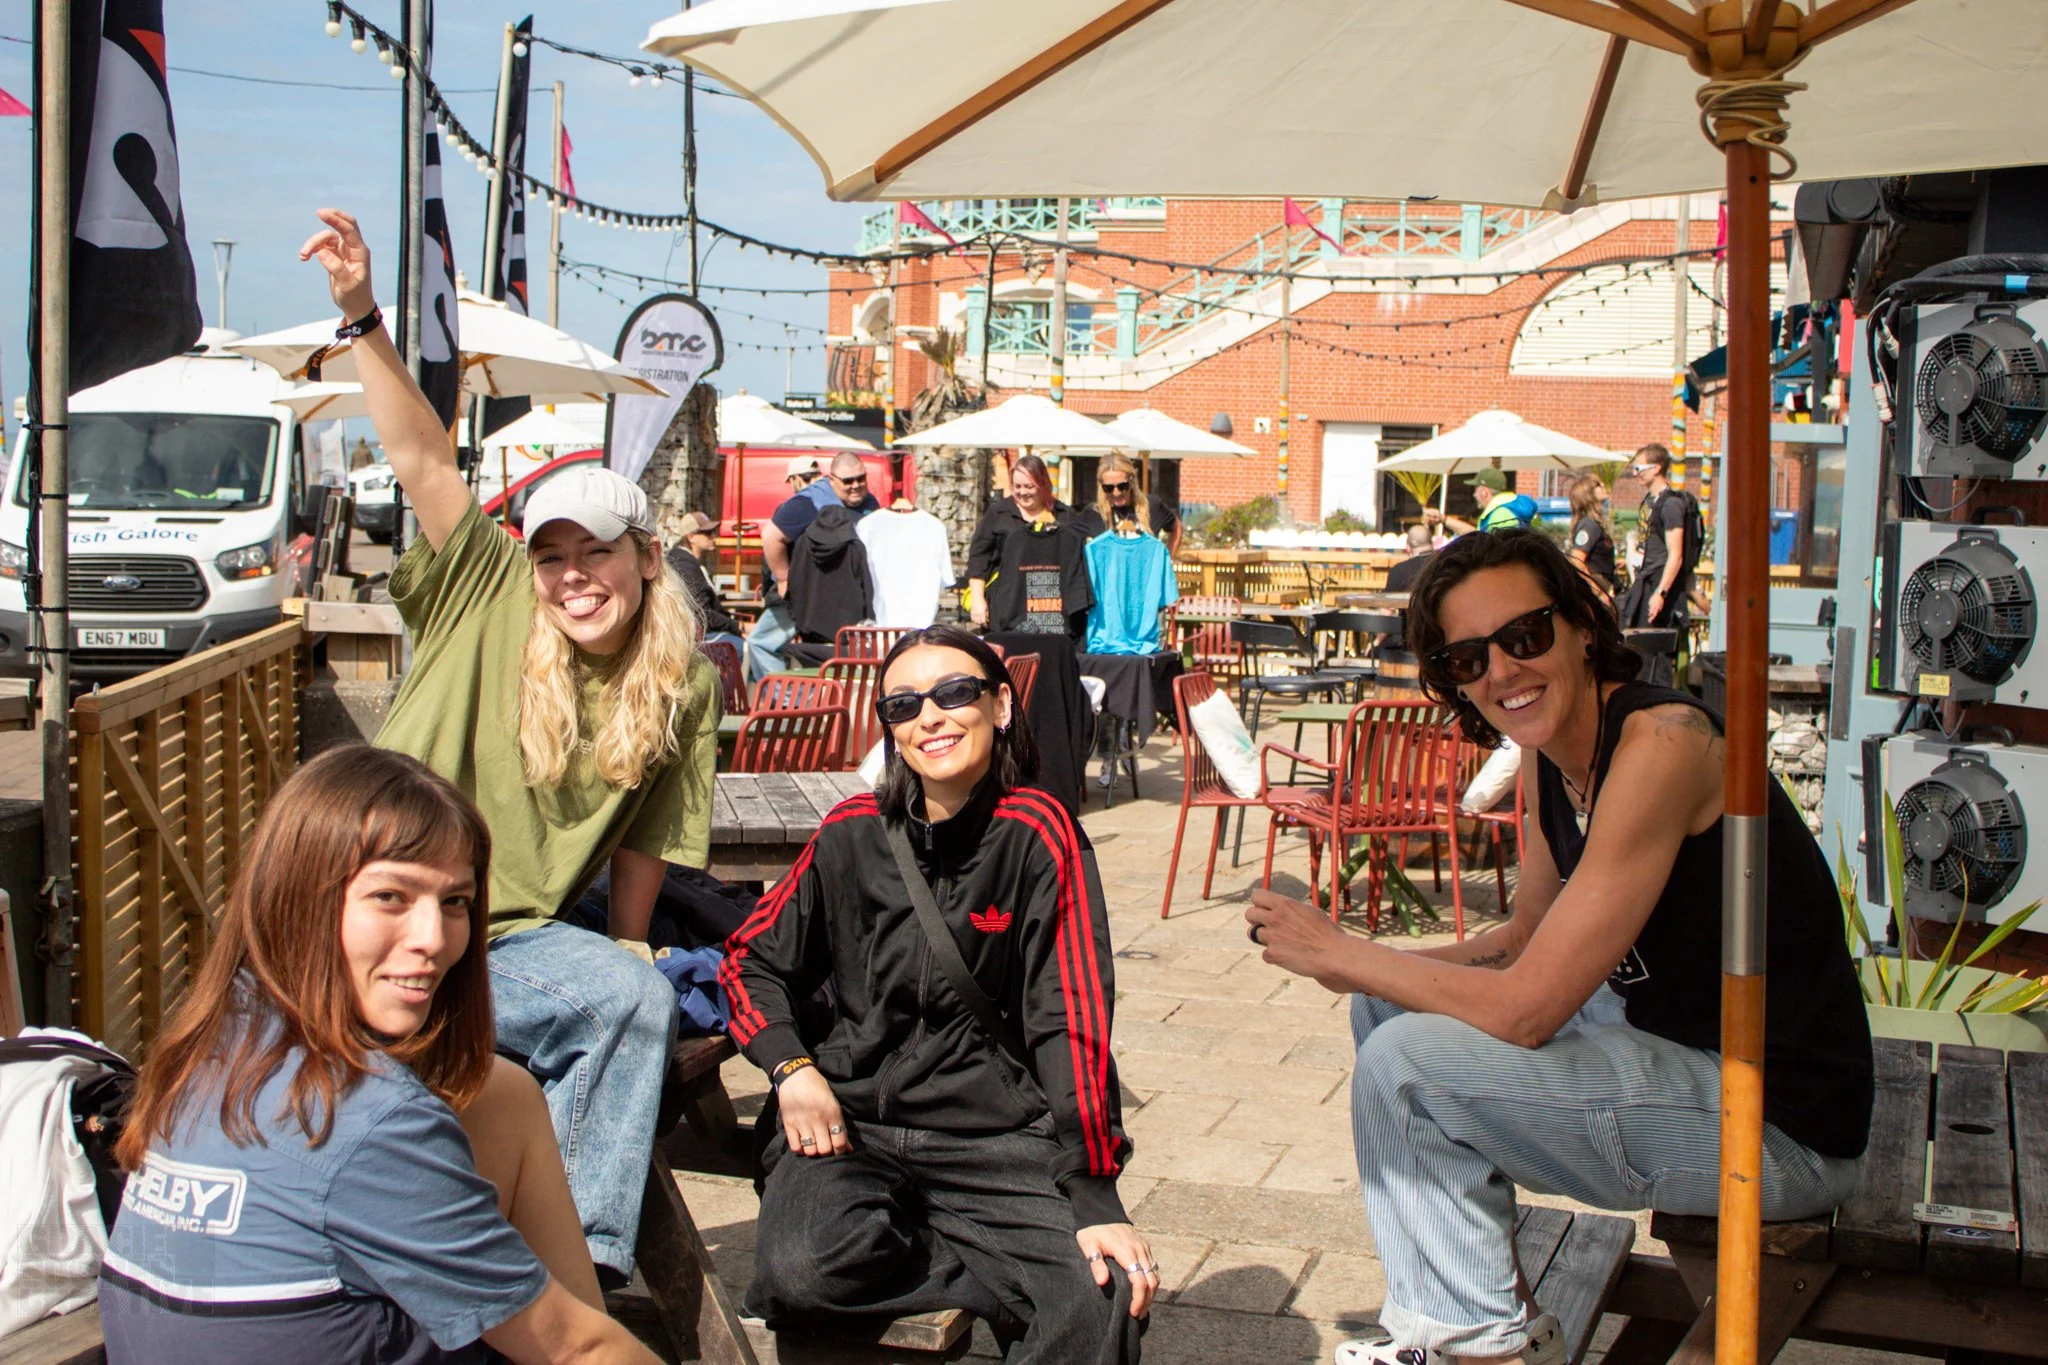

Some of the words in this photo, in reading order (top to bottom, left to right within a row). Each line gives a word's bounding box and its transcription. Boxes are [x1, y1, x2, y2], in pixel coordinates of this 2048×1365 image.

[628, 367, 689, 382] GISTRATION
[831, 411, 855, 421] Coffee
[69, 532, 107, 544] ish
[118, 528, 198, 543] Galore
[85, 631, 124, 645] EN67
[123, 1165, 231, 1218] HELBY
[177, 1216, 205, 1233] INC.
